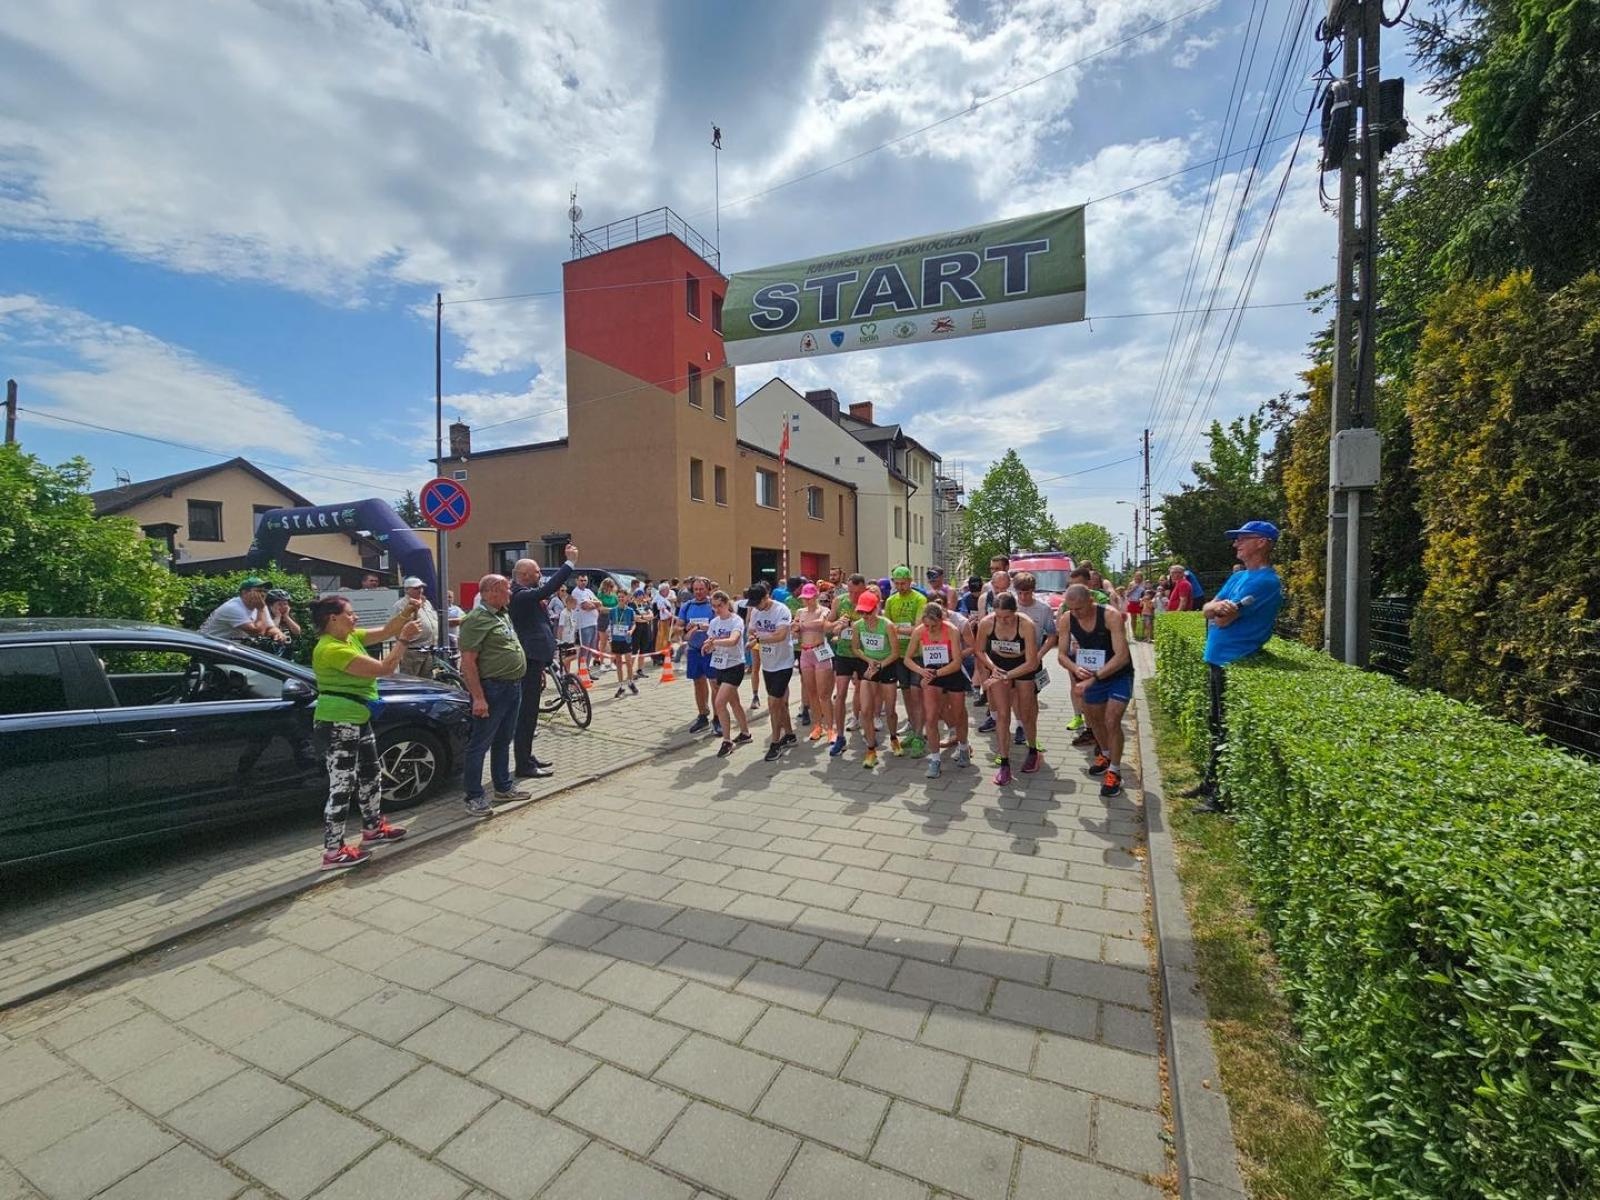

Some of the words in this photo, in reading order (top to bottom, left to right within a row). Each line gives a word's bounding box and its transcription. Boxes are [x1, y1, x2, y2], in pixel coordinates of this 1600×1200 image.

[749, 238, 1050, 331] START
[281, 511, 341, 530] START
[865, 638, 879, 647] 202
[929, 652, 942, 660] 201
[1083, 656, 1097, 665] 152
